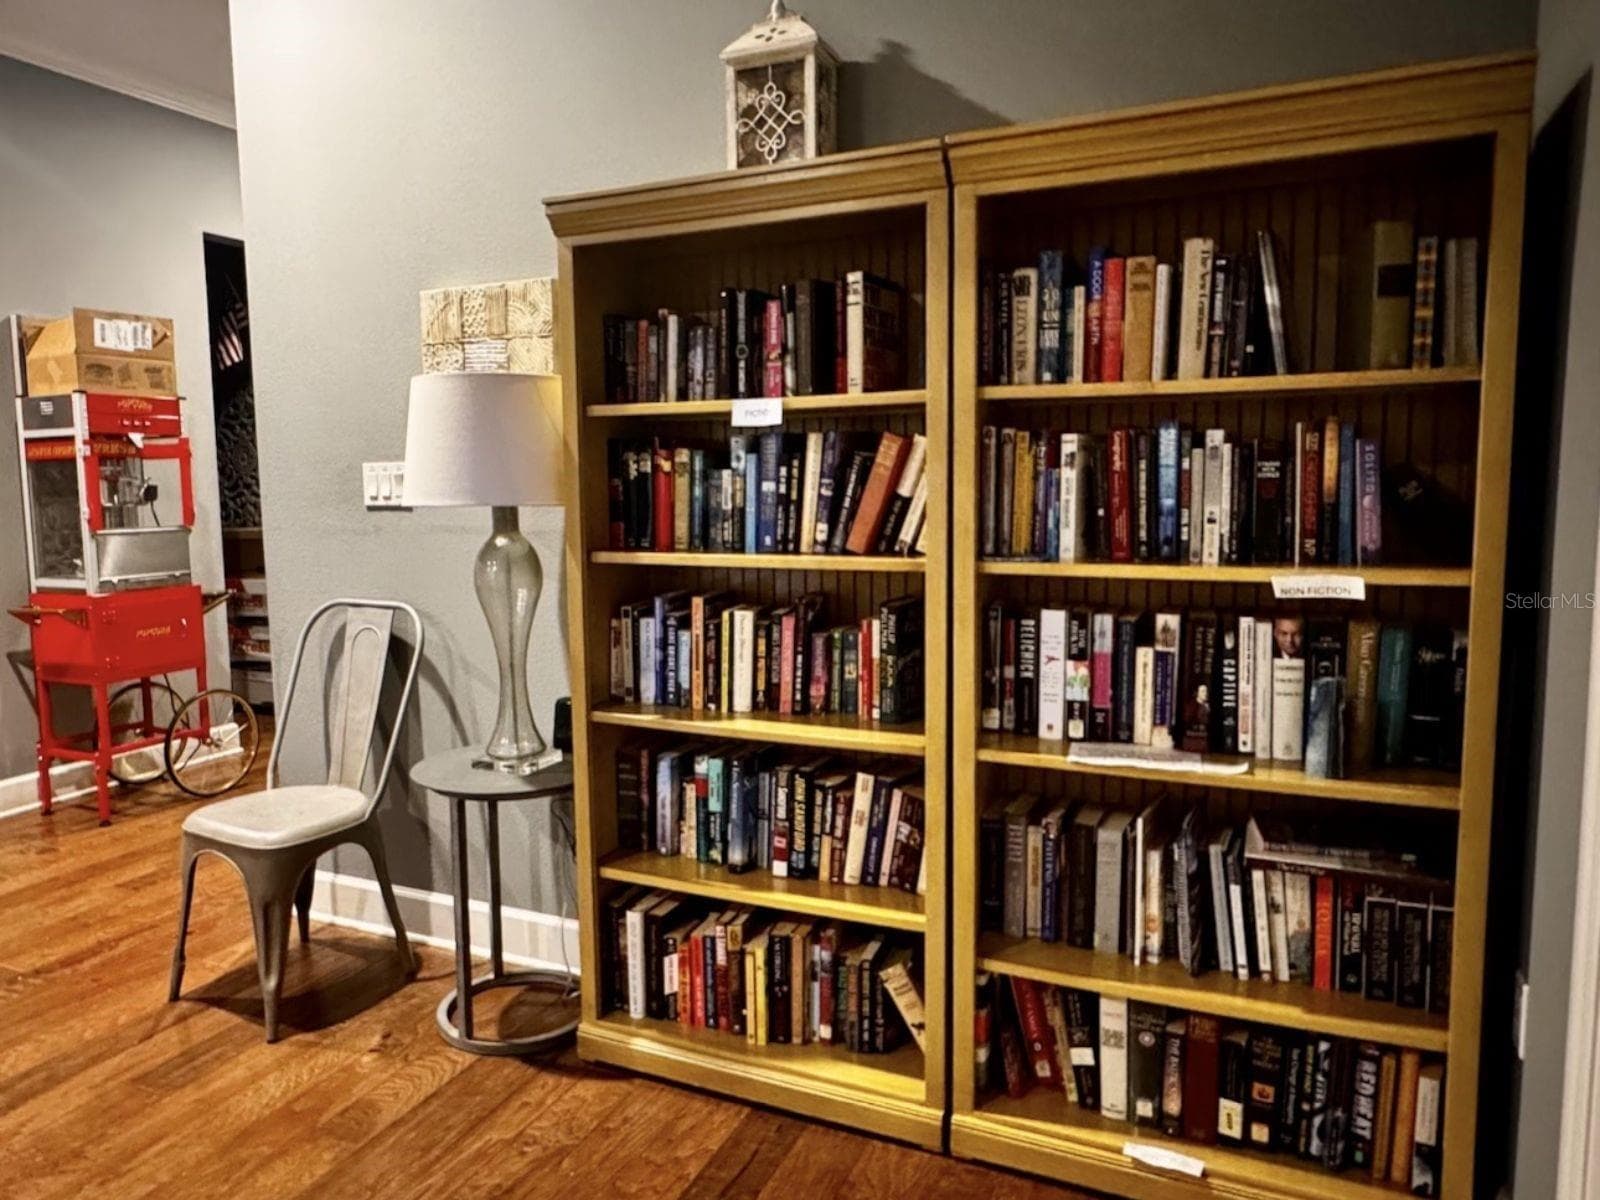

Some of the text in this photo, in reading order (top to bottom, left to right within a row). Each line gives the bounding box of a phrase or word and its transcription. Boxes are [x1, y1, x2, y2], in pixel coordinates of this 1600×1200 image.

[1364, 444, 1376, 493] SOLITO
[1280, 585, 1351, 596] NON FICTION
[1020, 618, 1036, 678] BELICHICK
[1222, 658, 1236, 707] CAPTIVE
